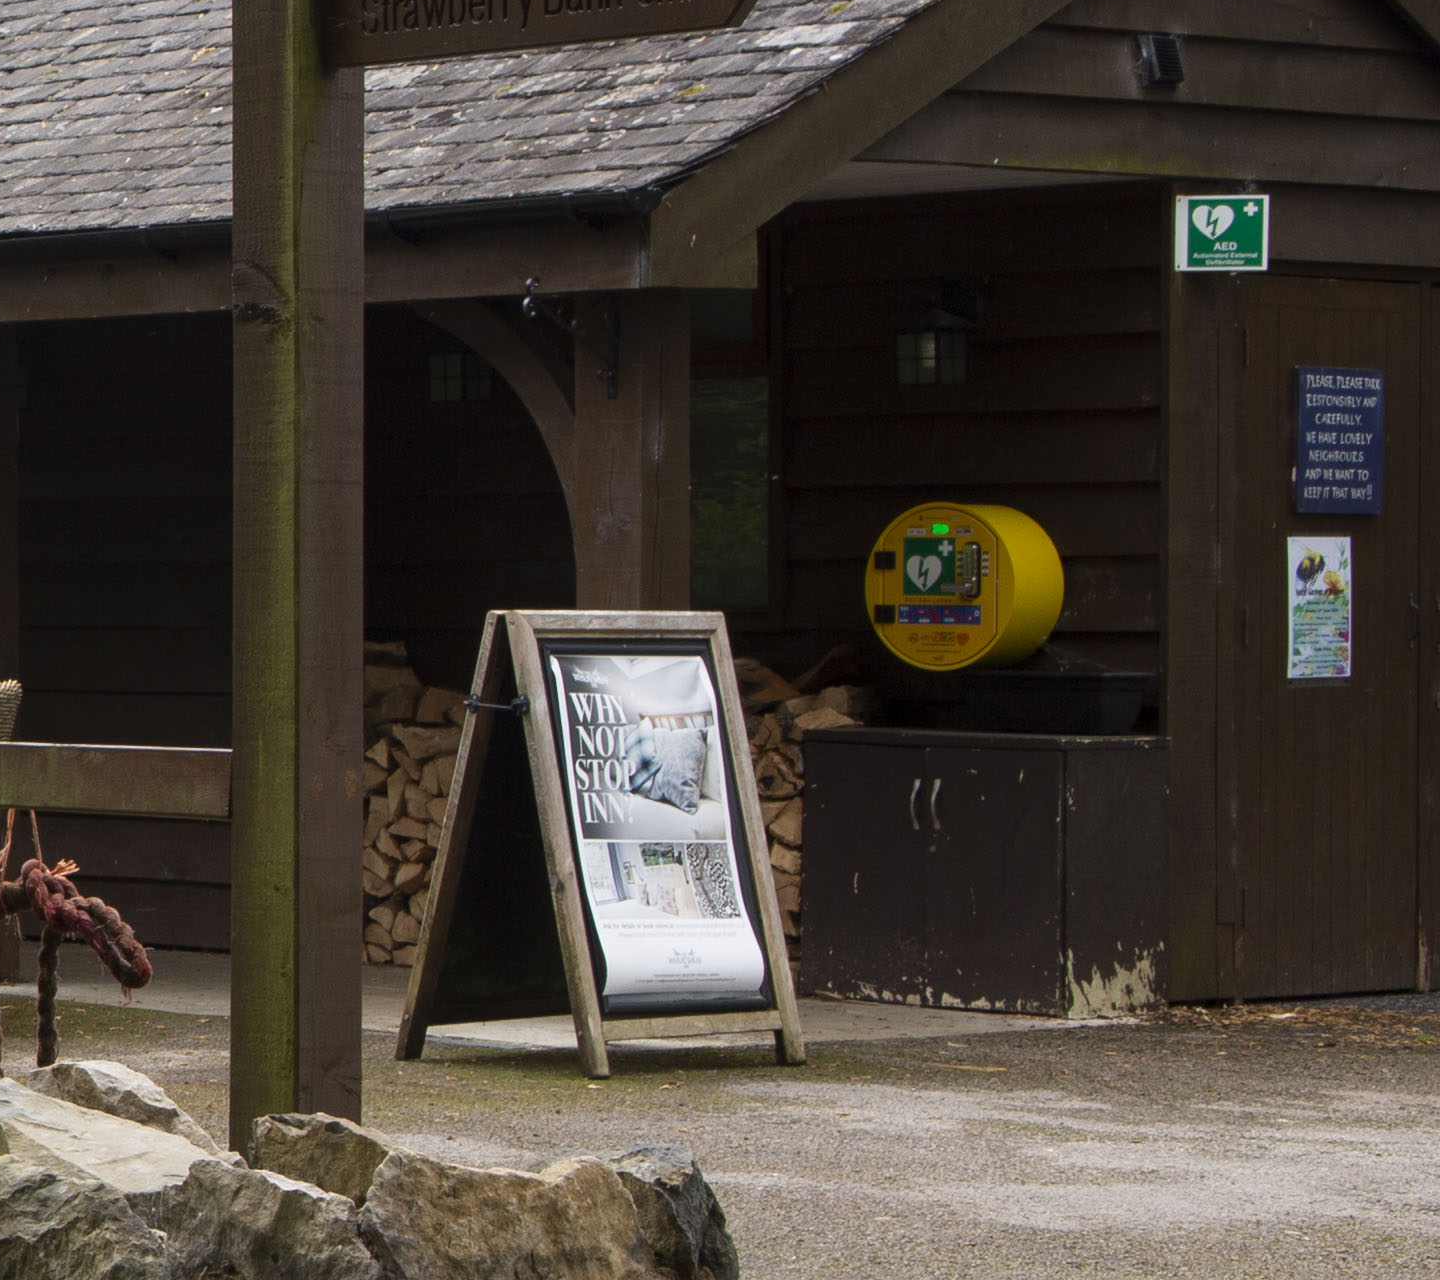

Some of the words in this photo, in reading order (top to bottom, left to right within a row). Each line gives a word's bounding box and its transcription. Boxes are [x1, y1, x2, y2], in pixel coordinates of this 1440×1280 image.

[1213, 242, 1238, 251] AED
[1336, 375, 1363, 389] PLEASE
[1363, 397, 1377, 408] AND
[1306, 431, 1316, 444] WE
[1318, 432, 1337, 444] HAVE
[1340, 432, 1373, 445] LOVELY
[1309, 449, 1364, 462] NEIGHBOURS
[1305, 468, 1321, 480] AND
[1323, 468, 1333, 480] WE
[1334, 469, 1354, 481] WANT
[1358, 469, 1369, 481] TO
[1303, 486, 1322, 499] KEEP
[1323, 486, 1330, 499] IT
[1331, 486, 1349, 500] THAT
[569, 692, 627, 724] WHY
[576, 725, 629, 758] NOT
[575, 758, 636, 791] STOP
[583, 791, 635, 824] INN?
